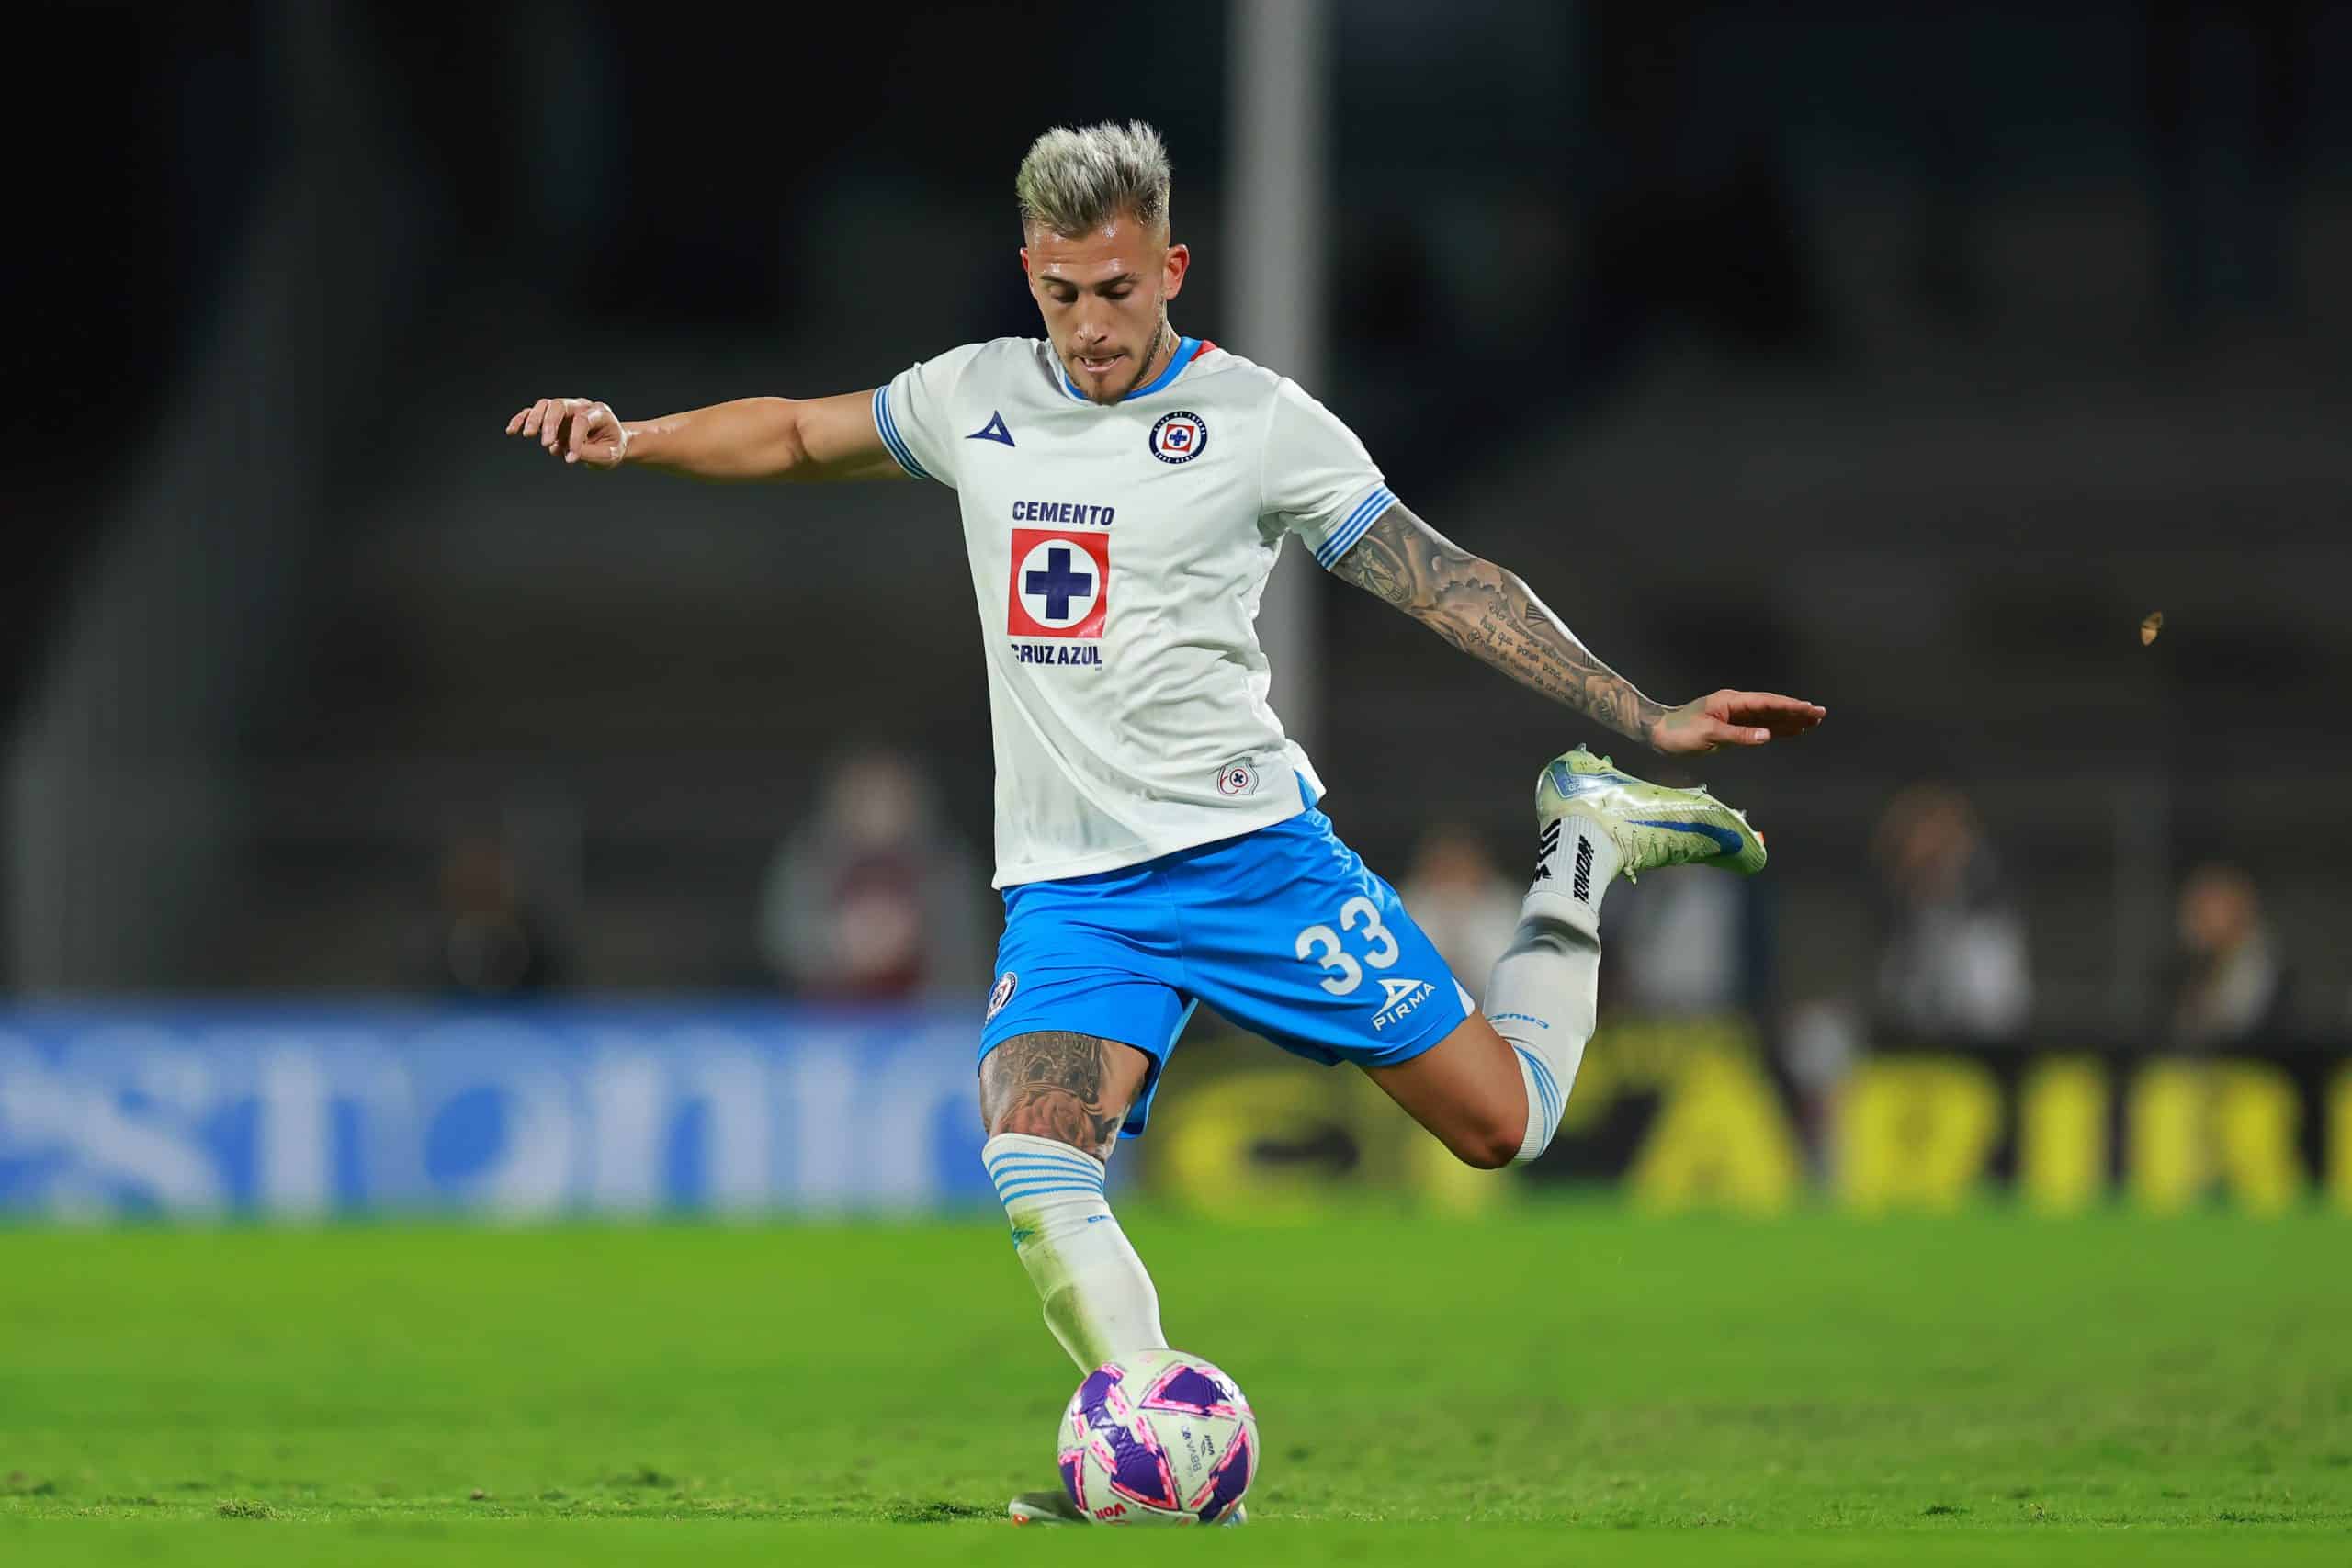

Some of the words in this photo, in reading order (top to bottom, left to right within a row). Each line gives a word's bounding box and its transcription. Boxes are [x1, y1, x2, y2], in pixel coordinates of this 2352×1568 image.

[1012, 500, 1114, 526] CEMENTO
[1057, 645, 1102, 665] AZUL
[1295, 896, 1399, 996] 33
[1373, 982, 1436, 1031] PIRMA
